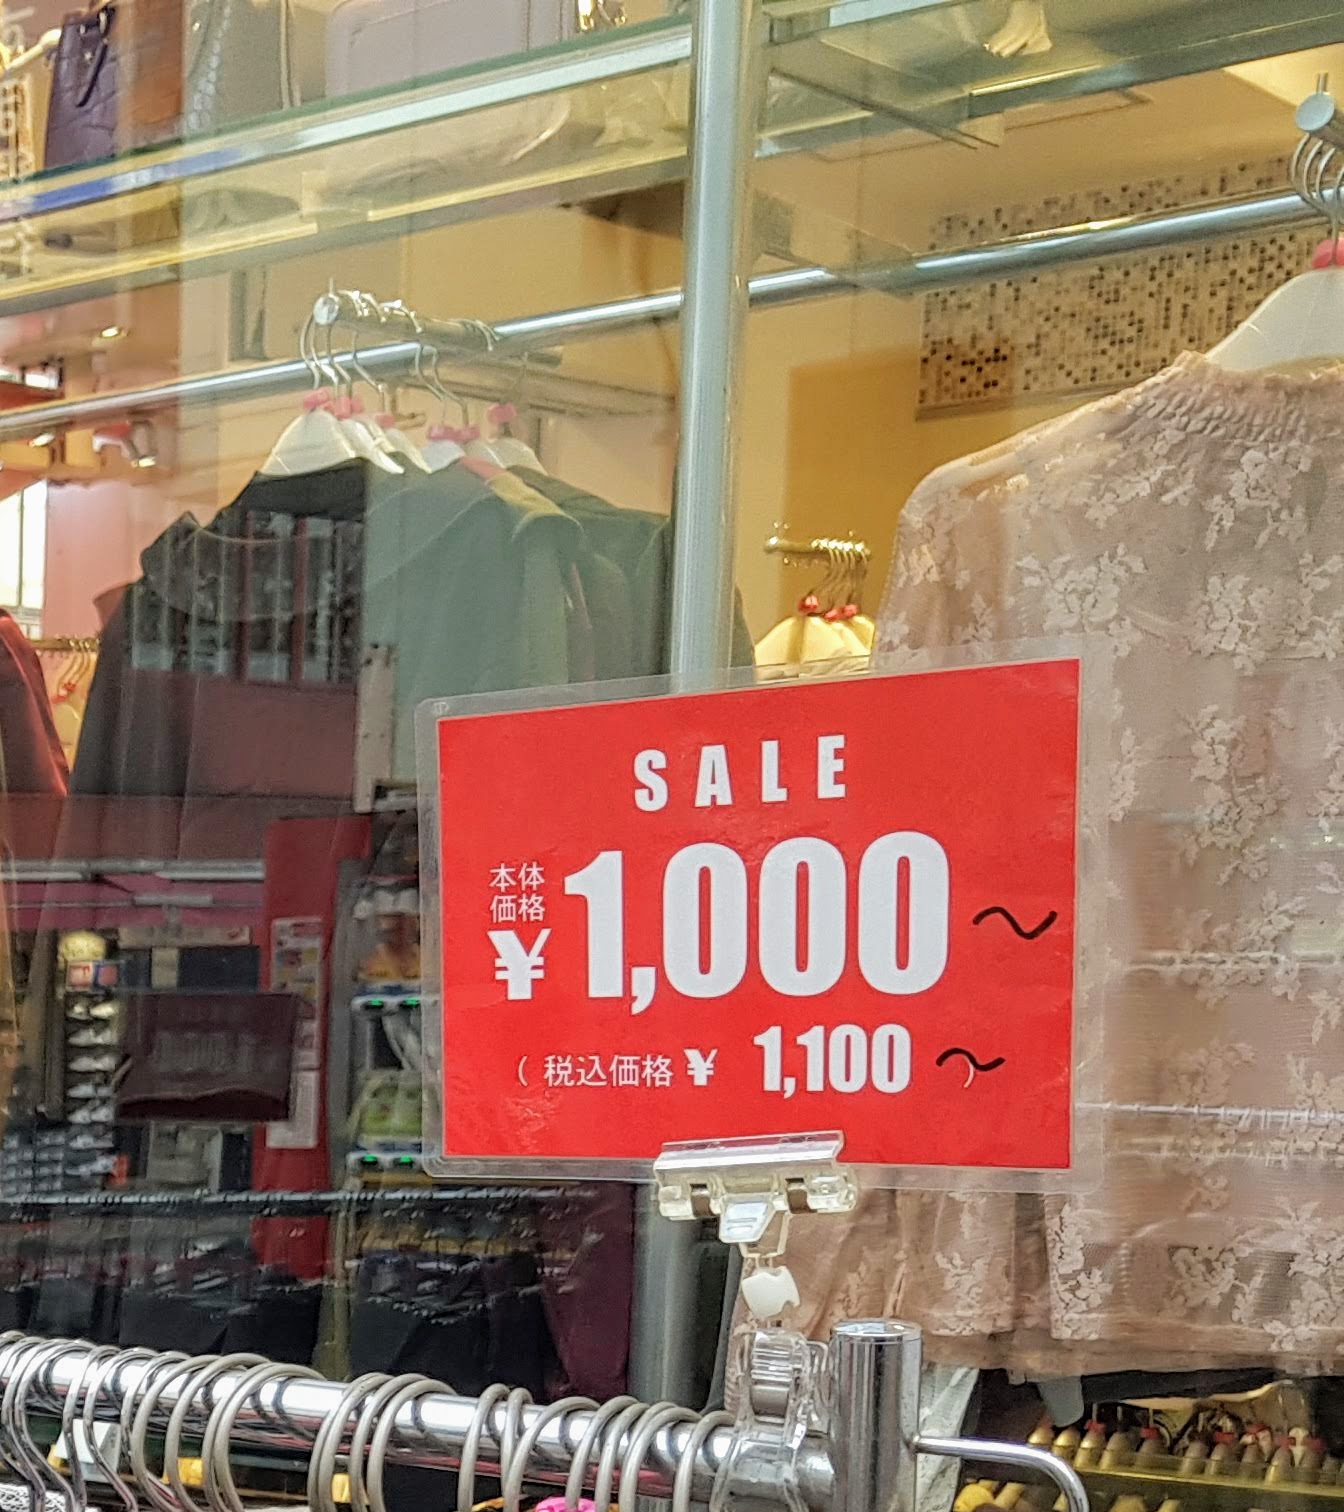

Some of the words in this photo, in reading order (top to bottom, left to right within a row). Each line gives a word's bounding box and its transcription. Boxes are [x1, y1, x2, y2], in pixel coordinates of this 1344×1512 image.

[633, 734, 847, 812] SALE
[488, 862, 546, 892] 本体
[488, 893, 546, 923] 価格
[753, 1022, 912, 1099] 1,100
